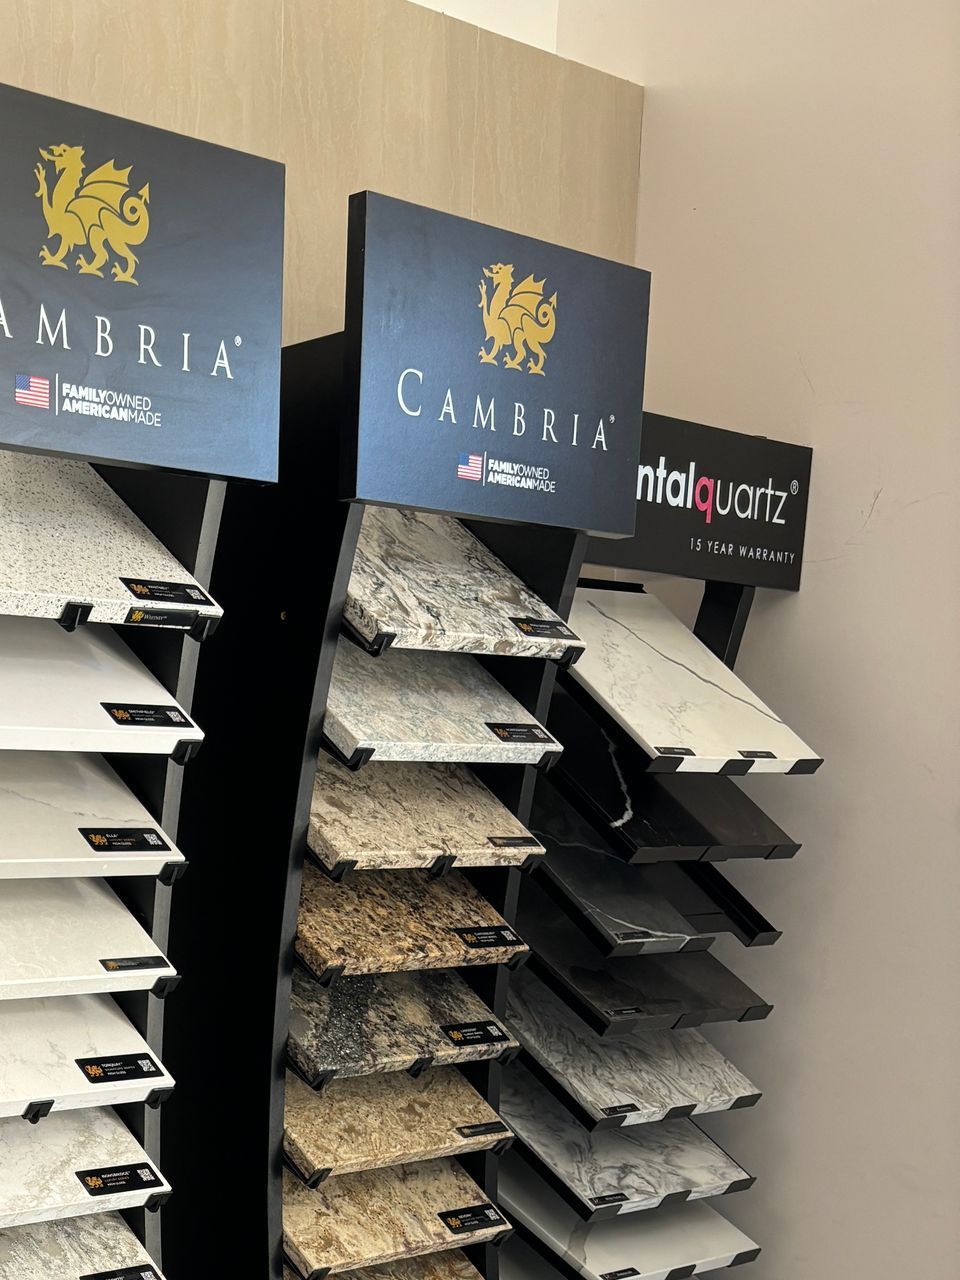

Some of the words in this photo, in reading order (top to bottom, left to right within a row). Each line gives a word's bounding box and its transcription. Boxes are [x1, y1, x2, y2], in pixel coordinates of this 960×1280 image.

[62, 383, 152, 411] FAMILYOWNED
[61, 401, 162, 427] AMERICANMADE
[487, 458, 550, 480] FAMILYOWNED
[487, 472, 556, 493] AMERICANMADE
[690, 537, 702, 551] 15
[707, 540, 734, 556] YEAR
[739, 546, 795, 564] WARRANTY
